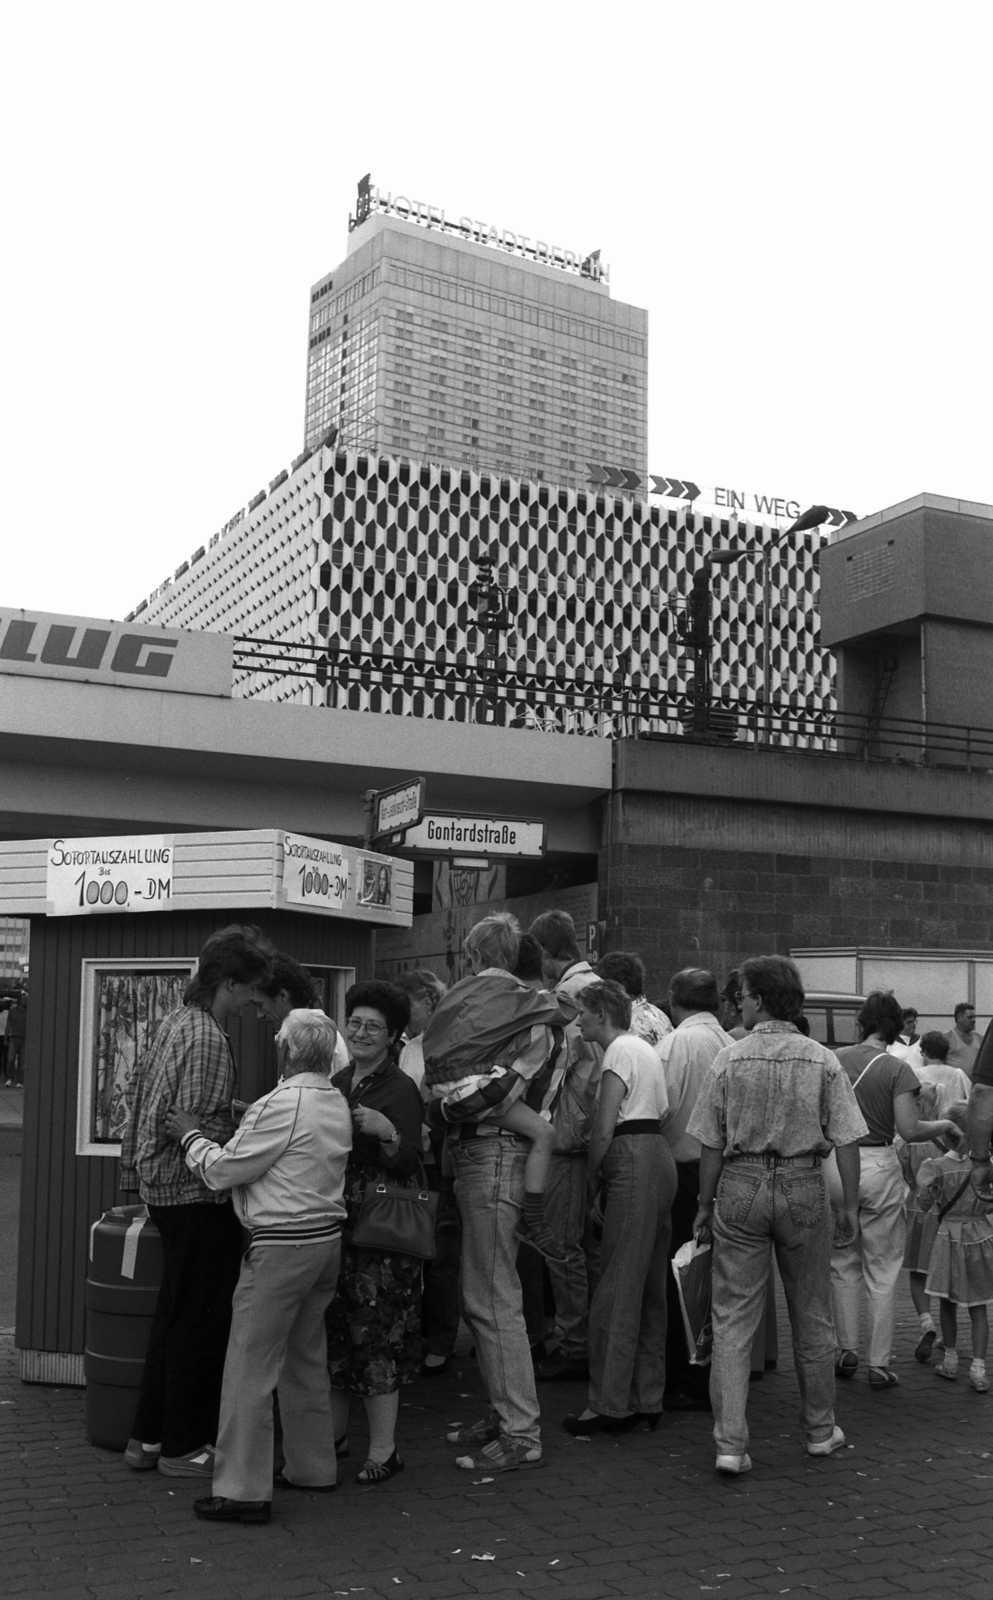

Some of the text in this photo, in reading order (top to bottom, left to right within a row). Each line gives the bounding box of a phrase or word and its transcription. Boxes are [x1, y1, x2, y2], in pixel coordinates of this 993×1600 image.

[375, 187, 611, 283] HOTEL STADT BERLIN
[714, 486, 801, 519] EIN WEG
[0, 617, 179, 678] LUG
[427, 820, 517, 845] Gontardstraße
